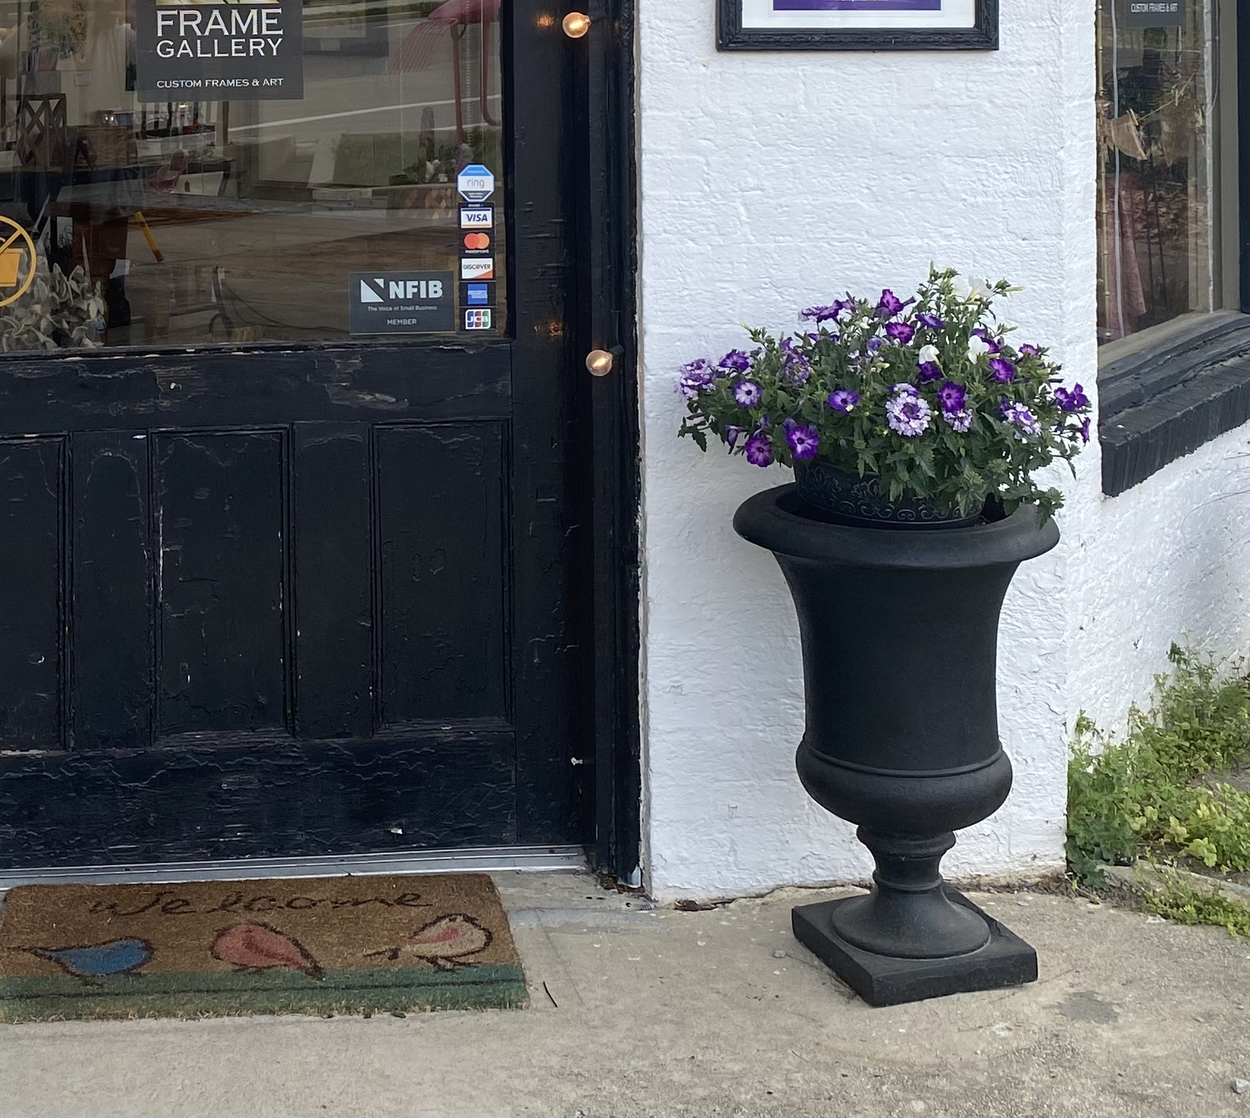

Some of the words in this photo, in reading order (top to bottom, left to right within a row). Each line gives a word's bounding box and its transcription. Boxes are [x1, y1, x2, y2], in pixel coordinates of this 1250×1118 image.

[1130, 3, 1149, 13] CUSTOM
[1149, 3, 1165, 13] FRAMES
[1170, 3, 1178, 13] ART
[156, 7, 283, 37] FRAME
[156, 38, 283, 59] GALLERY
[156, 79, 202, 89] CUSTOM
[204, 79, 250, 88] FRAMES
[251, 78, 260, 87] &
[262, 78, 284, 87] ART
[467, 179, 485, 189] ring
[465, 213, 488, 222] VISA
[389, 280, 443, 299] NFIB
